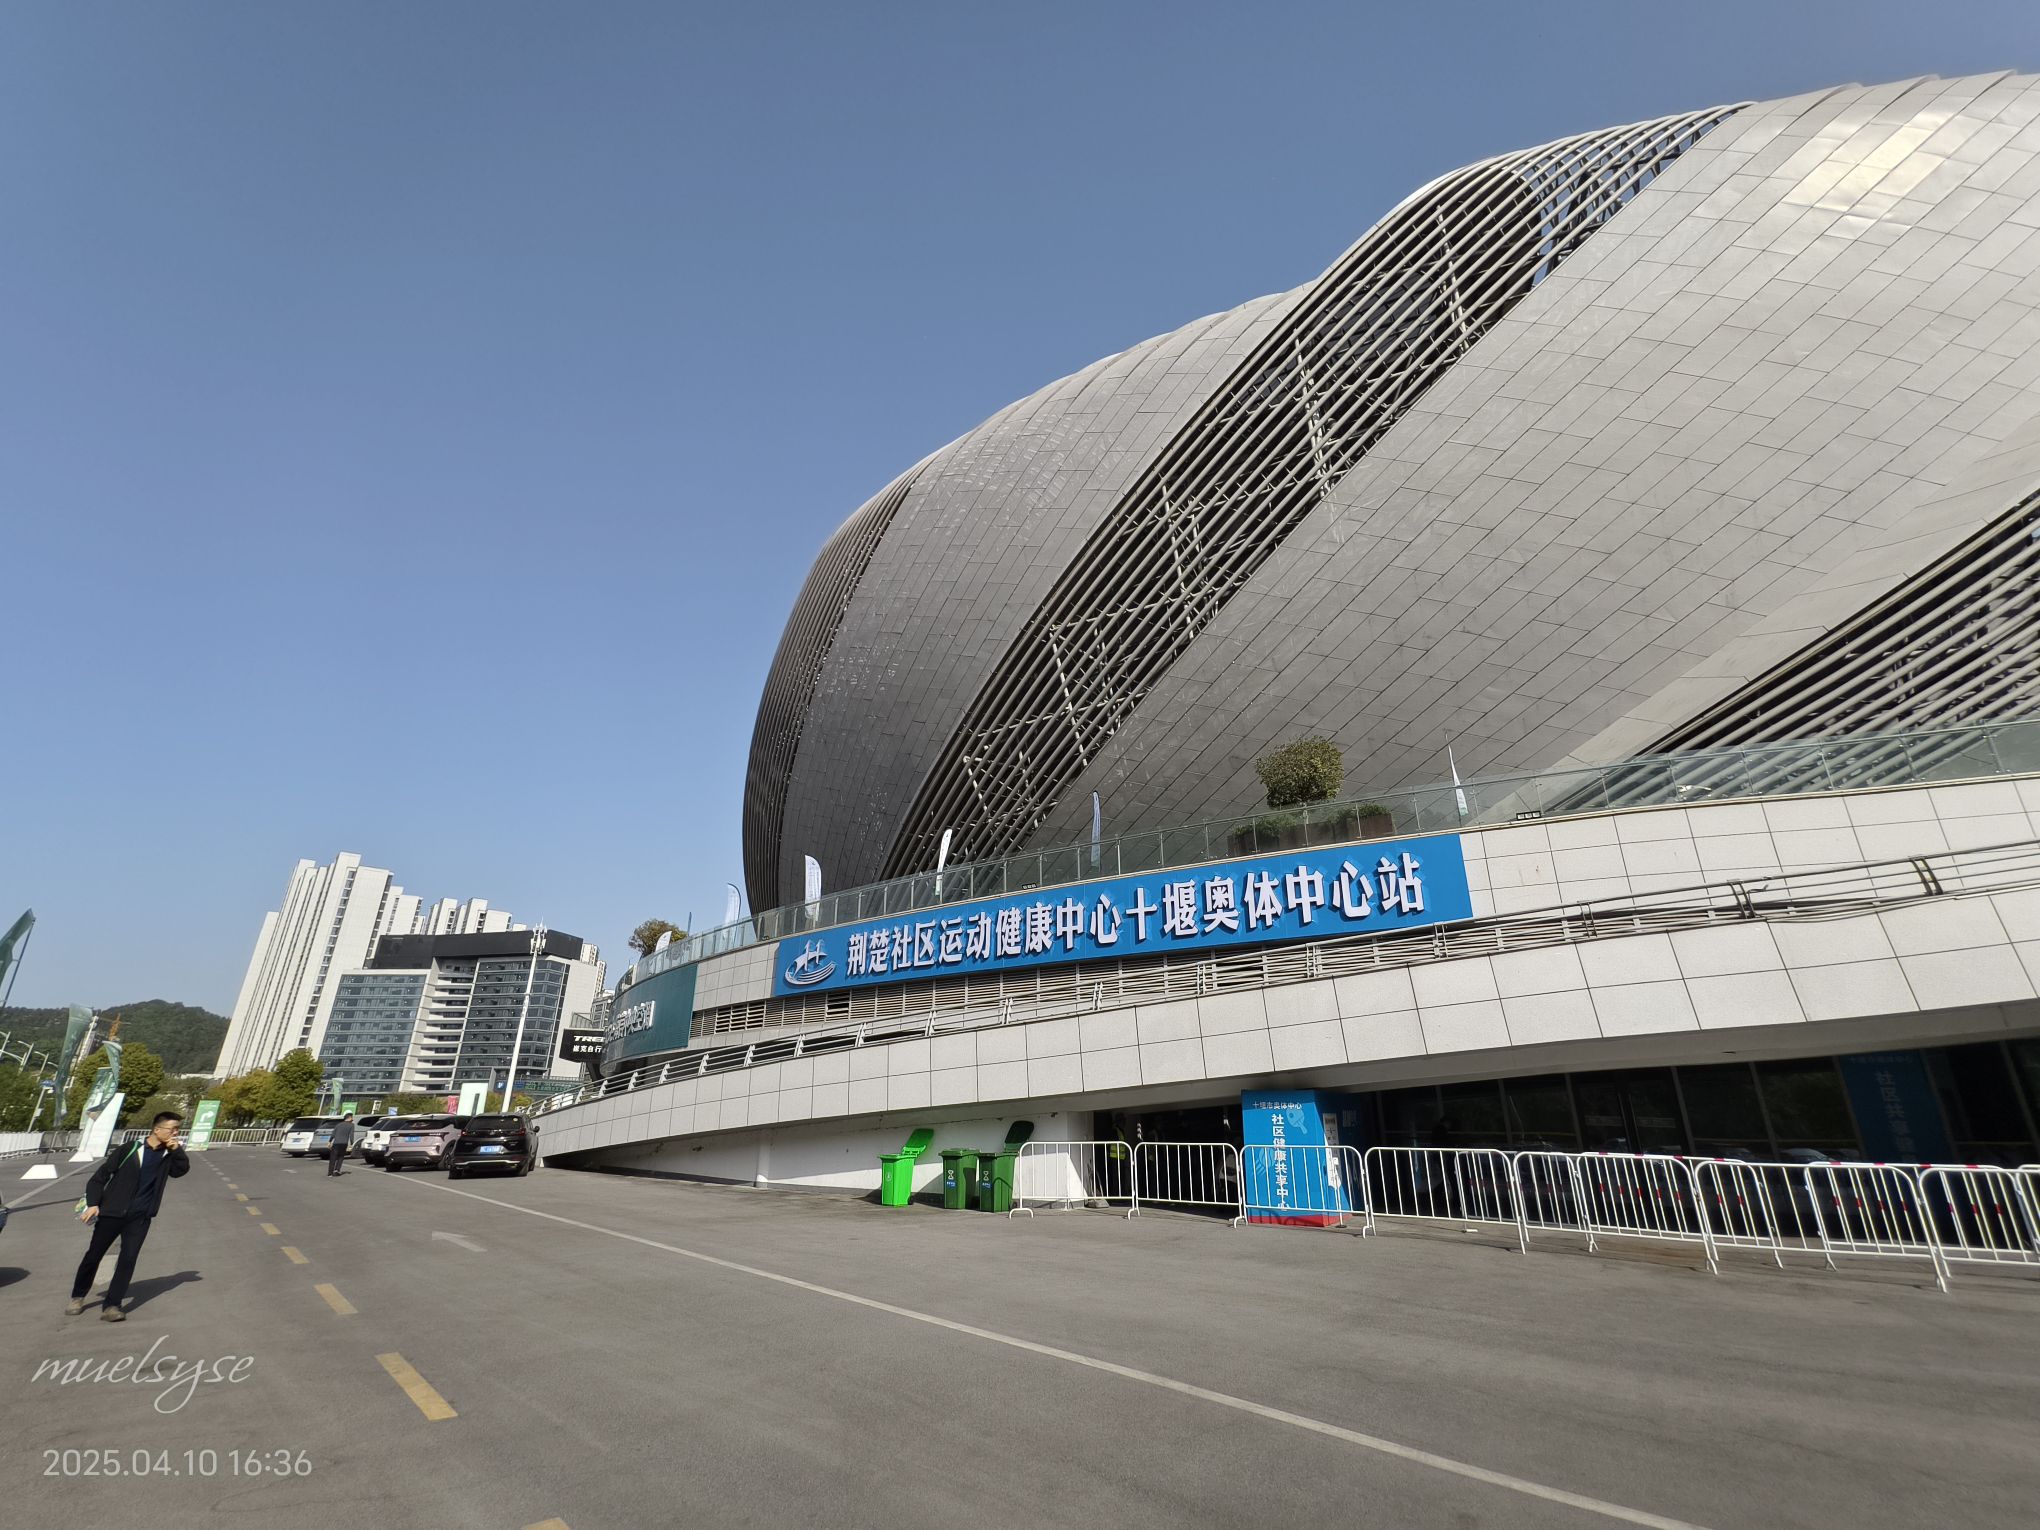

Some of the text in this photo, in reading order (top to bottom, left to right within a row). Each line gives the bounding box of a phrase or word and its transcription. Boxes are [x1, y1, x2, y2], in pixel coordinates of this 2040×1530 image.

[846, 851, 1425, 976] 荆楚社区运动健康中心十堰奥体中心站
[573, 1035, 604, 1043] TRE
